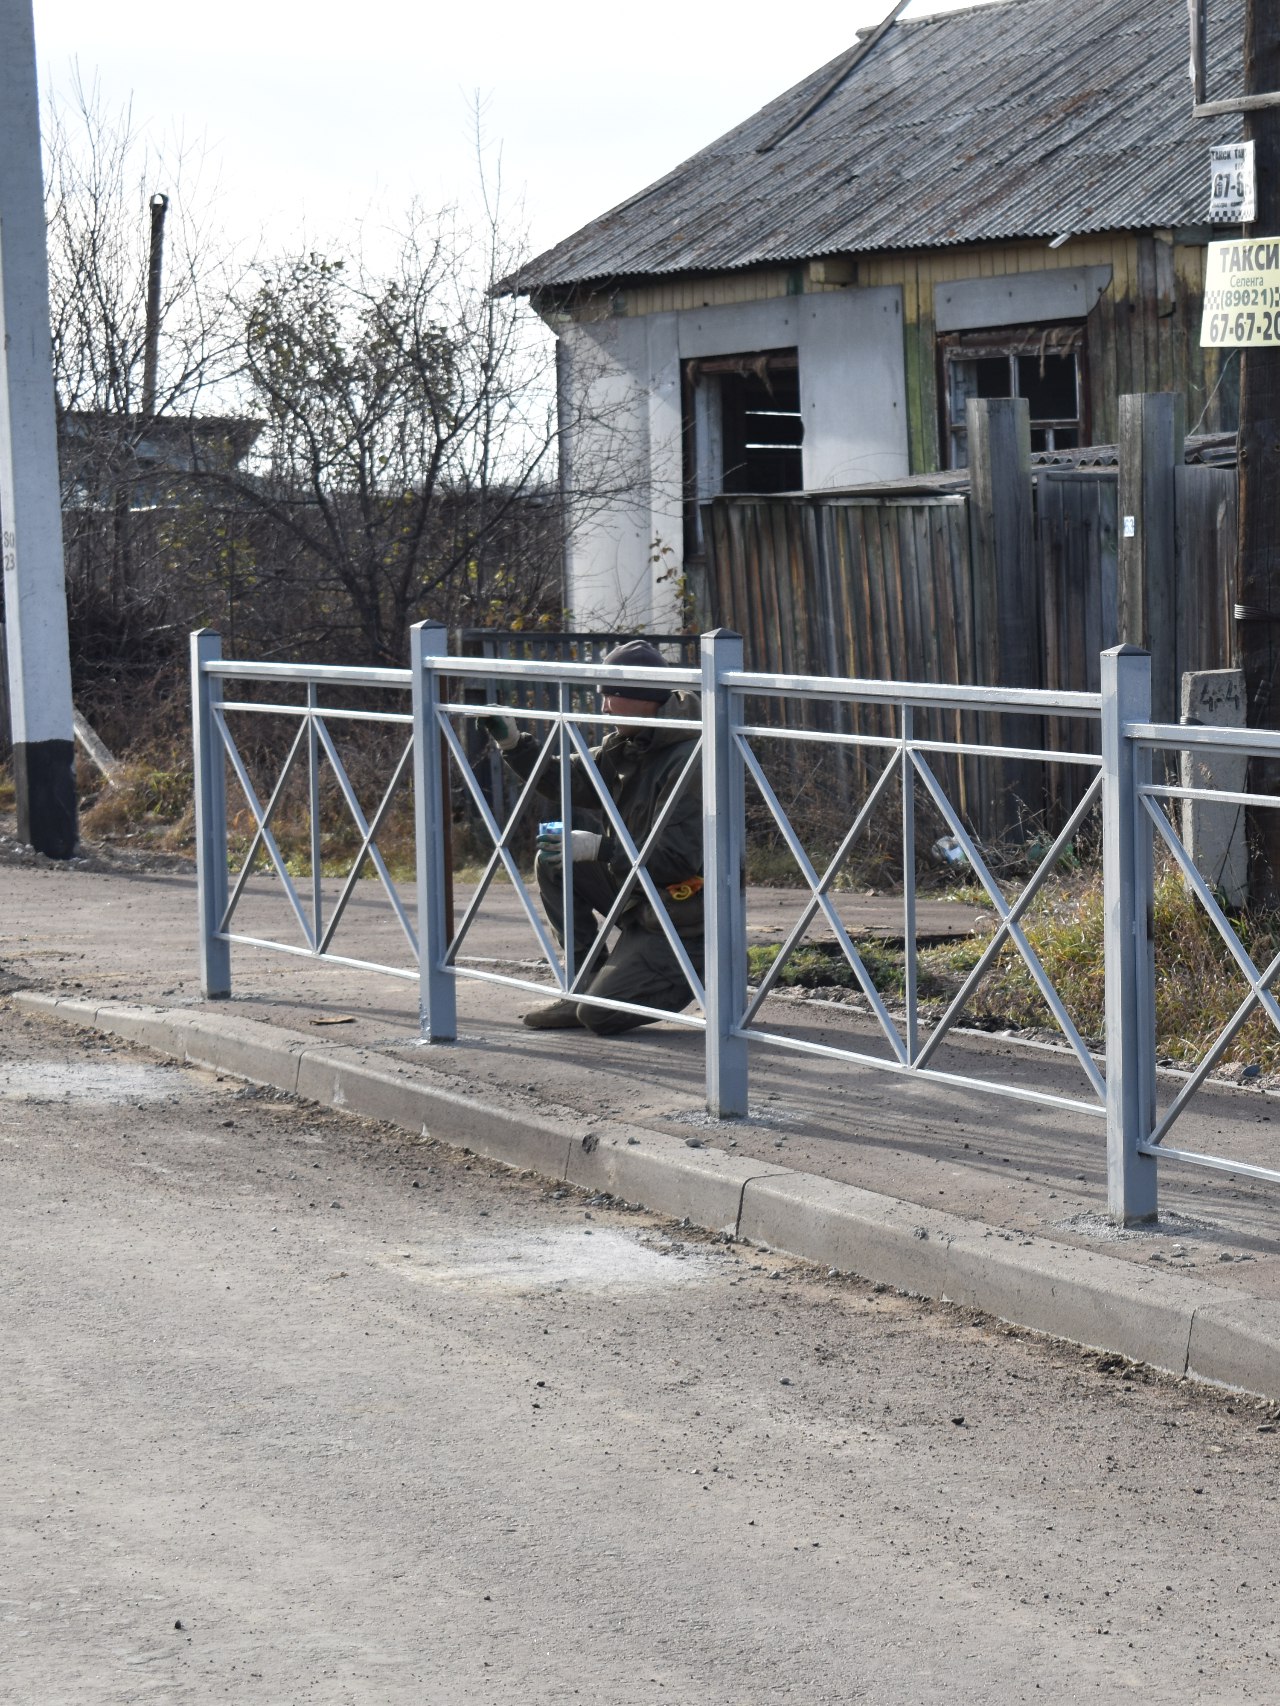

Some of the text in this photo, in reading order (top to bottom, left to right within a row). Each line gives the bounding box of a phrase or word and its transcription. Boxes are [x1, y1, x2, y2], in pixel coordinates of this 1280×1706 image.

[1220, 243, 1280, 273] ТАКСИ
[1230, 275, 1264, 287] Селенга
[1220, 287, 1274, 309] (89021)
